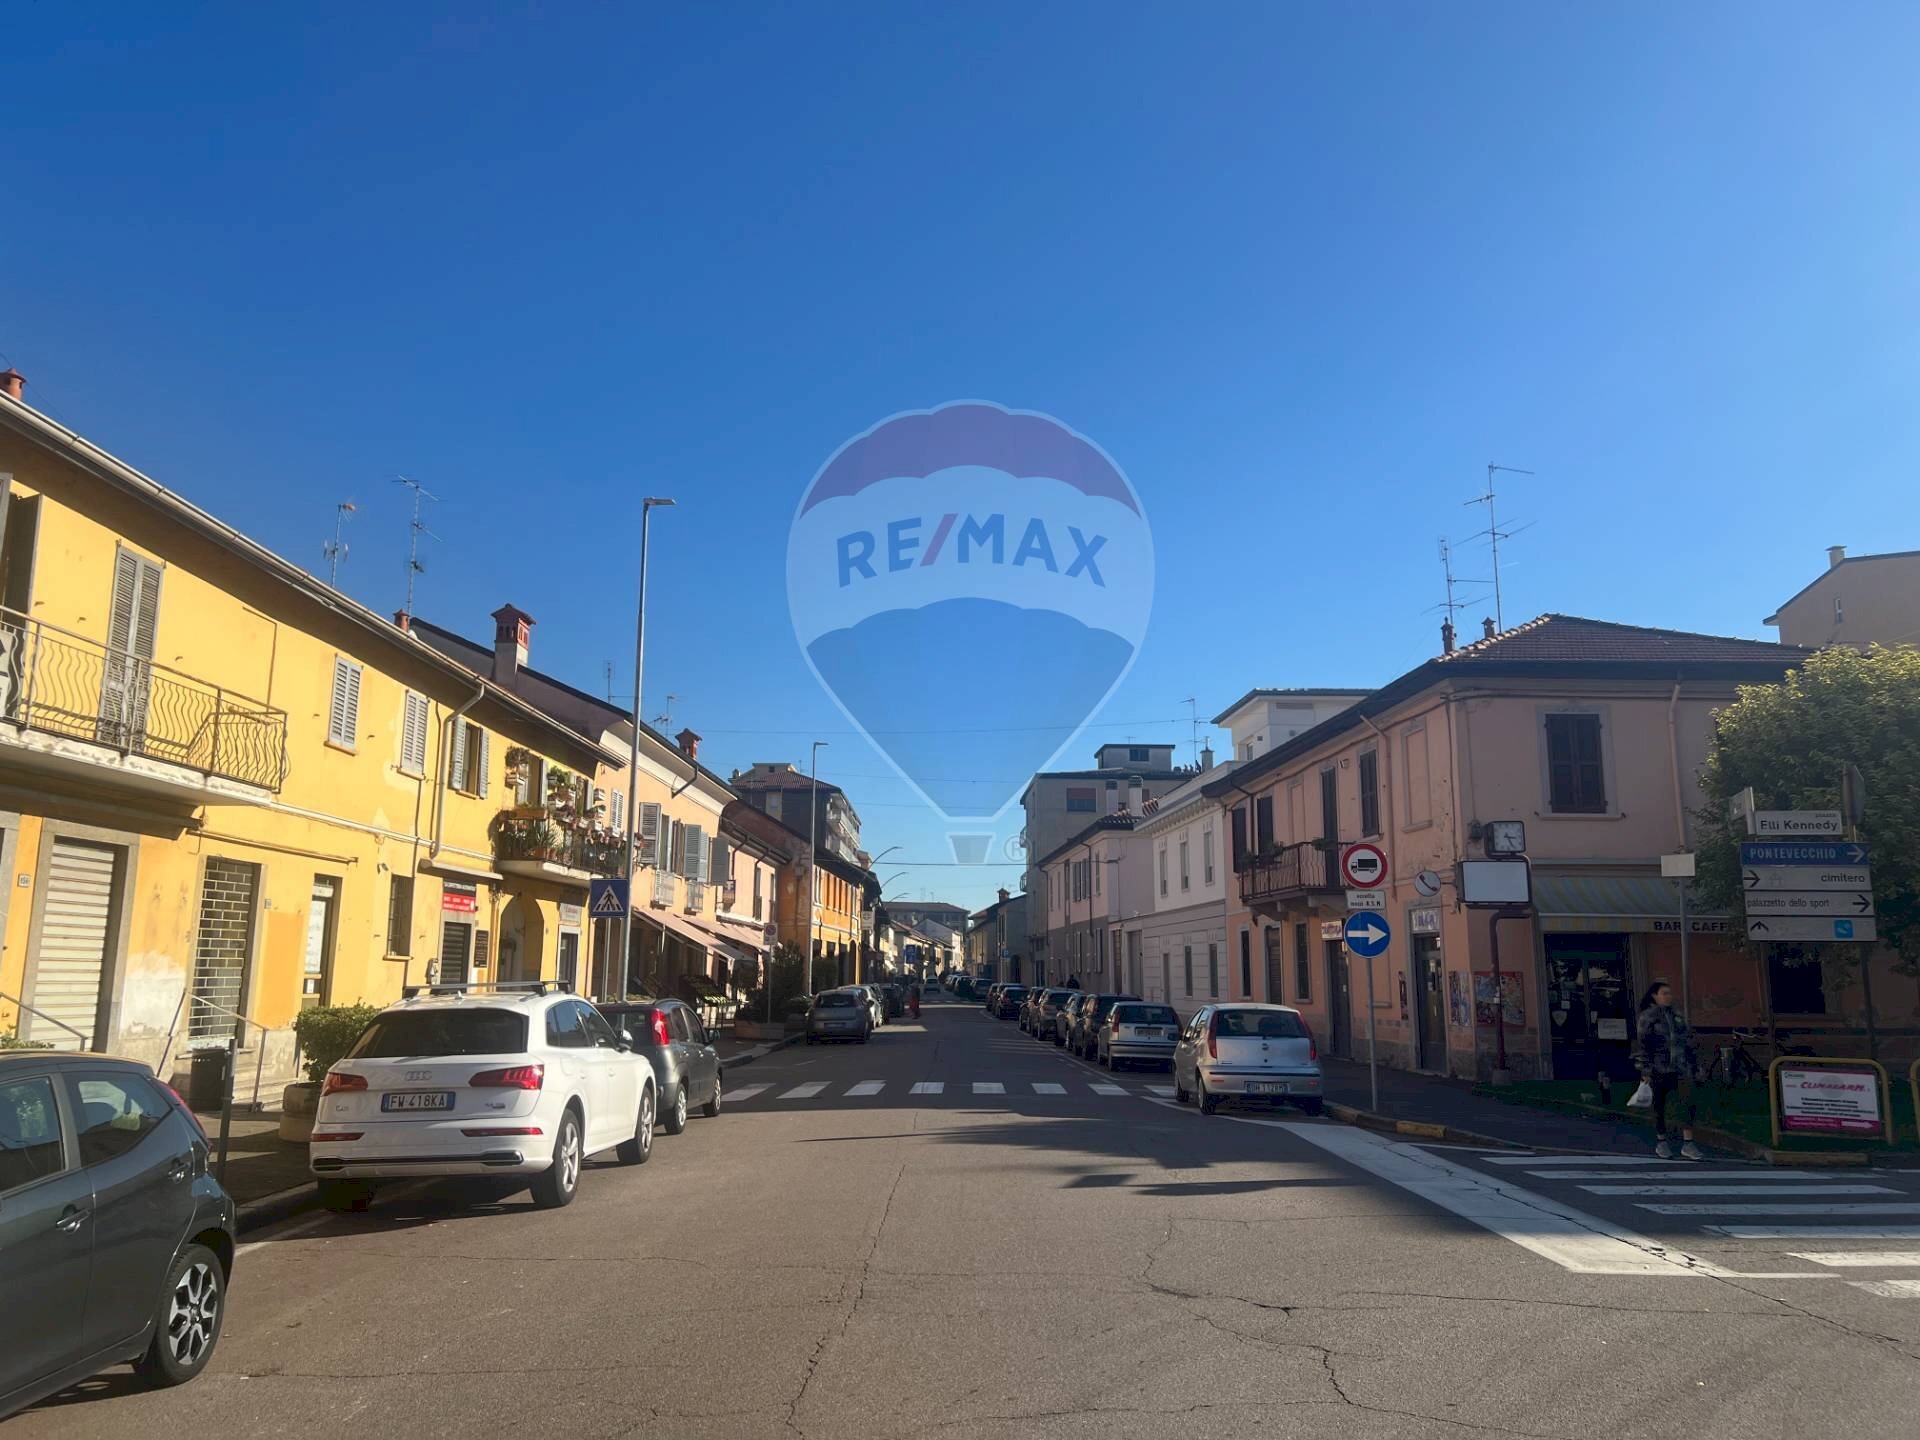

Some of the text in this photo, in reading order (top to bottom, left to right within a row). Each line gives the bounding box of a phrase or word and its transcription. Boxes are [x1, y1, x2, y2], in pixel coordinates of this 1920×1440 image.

[1784, 820, 1838, 834] Kennedy
[1750, 848, 1837, 859] PONTEVECCHIO
[1821, 872, 1866, 883] cimitero
[1747, 897, 1830, 909] palazzetto dello sport
[1654, 921, 1728, 932] BAR CAFF
[407, 1094, 447, 1108] 418KA
